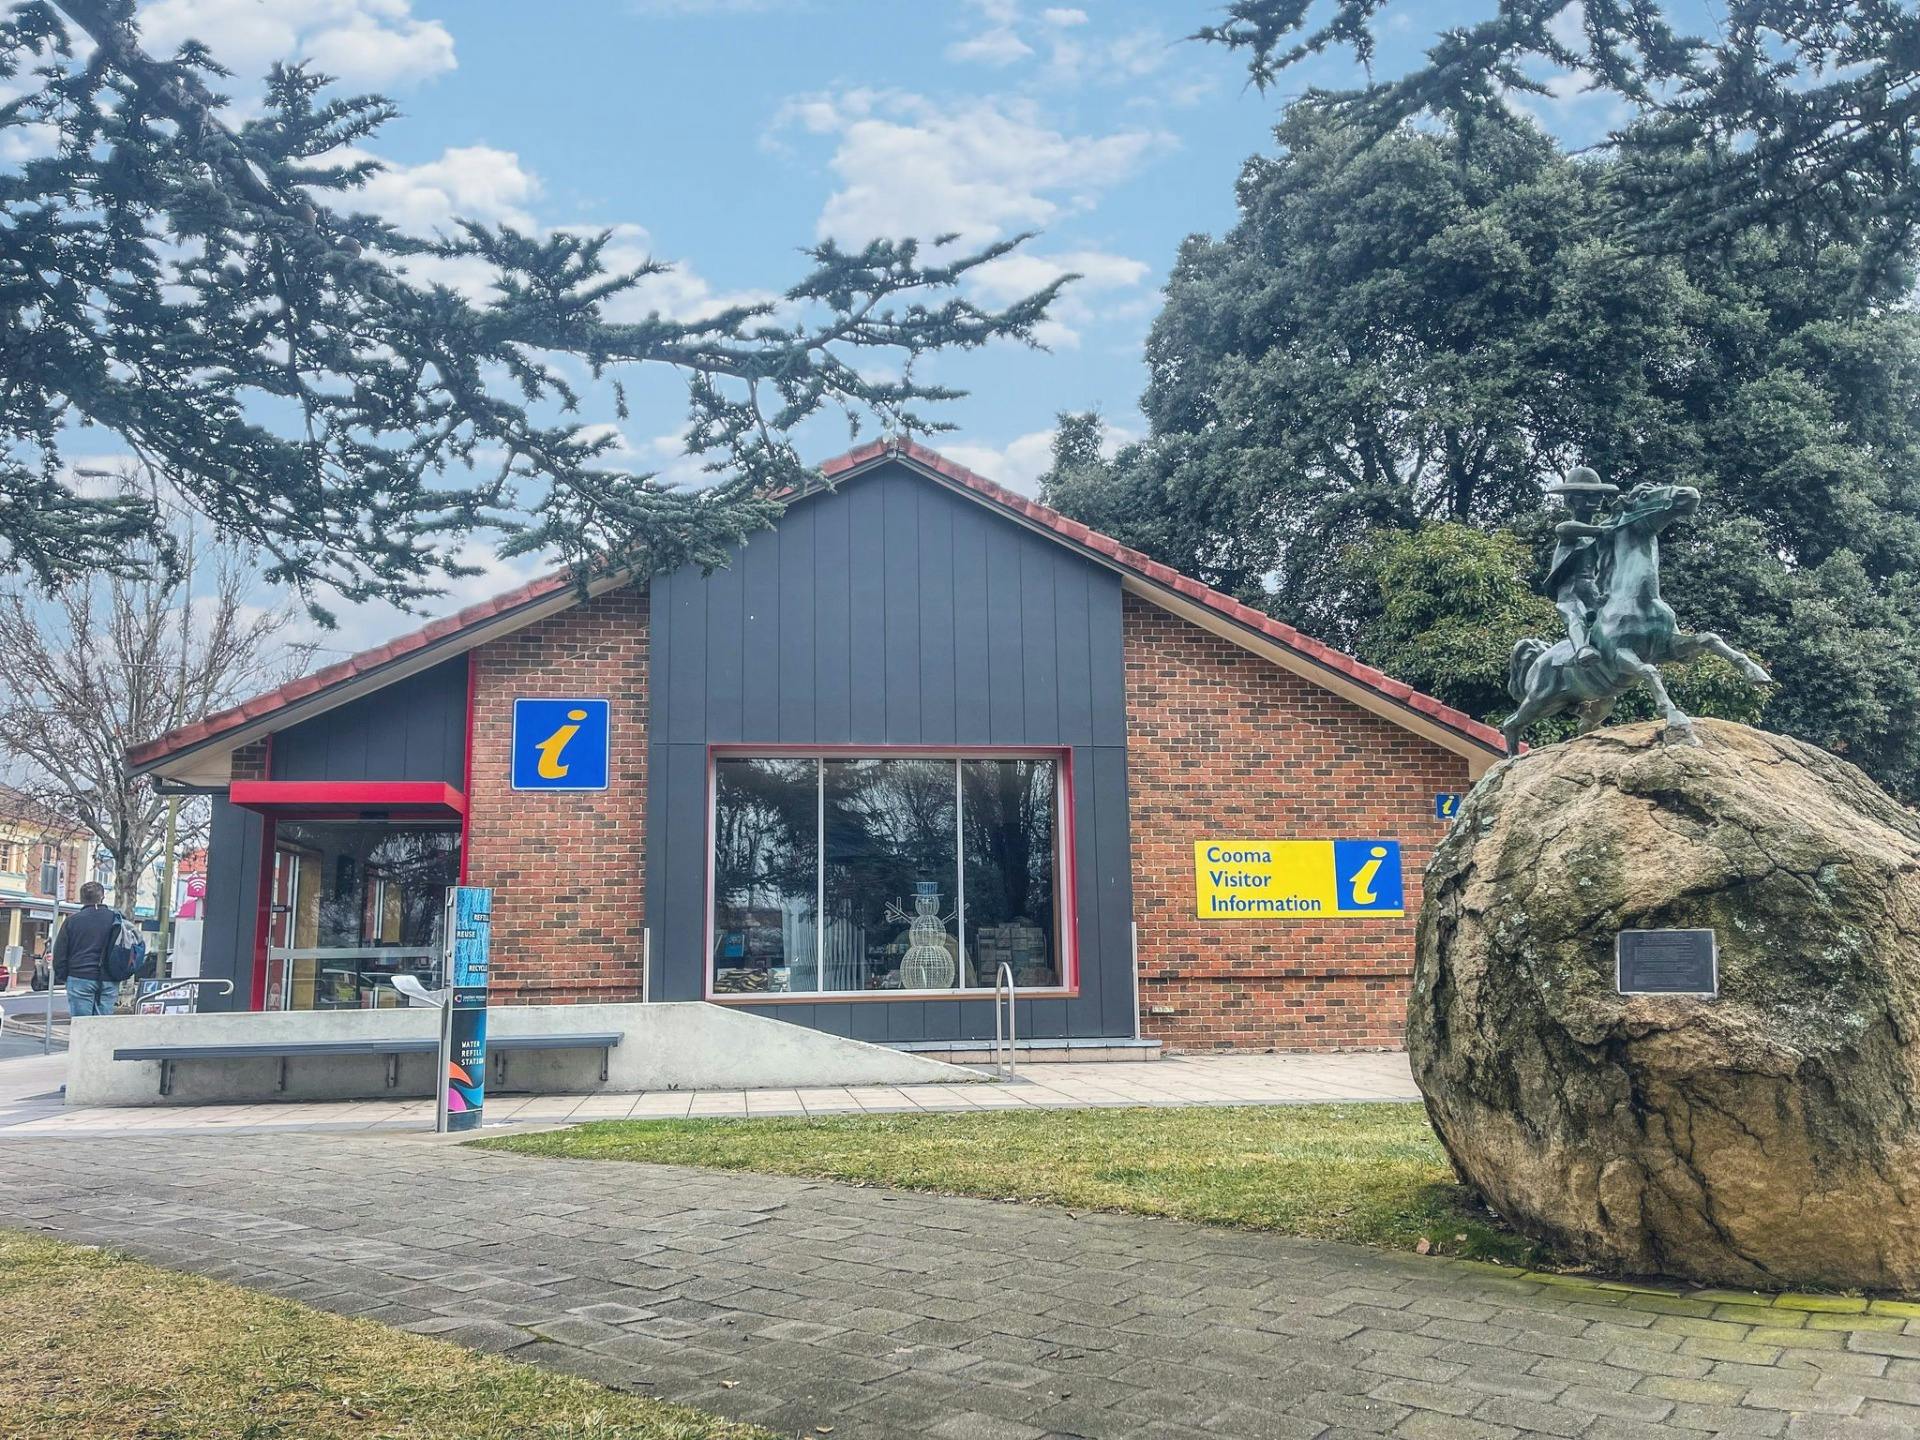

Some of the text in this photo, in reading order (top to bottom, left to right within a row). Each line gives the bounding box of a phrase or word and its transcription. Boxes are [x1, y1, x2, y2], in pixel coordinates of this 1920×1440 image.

[1206, 846, 1272, 863] Cooma
[1209, 870, 1272, 887] Visitor
[1211, 894, 1321, 912] Information
[456, 930, 476, 938] REUSE
[461, 1040, 480, 1048] WATER
[461, 1049, 482, 1057] REFILL
